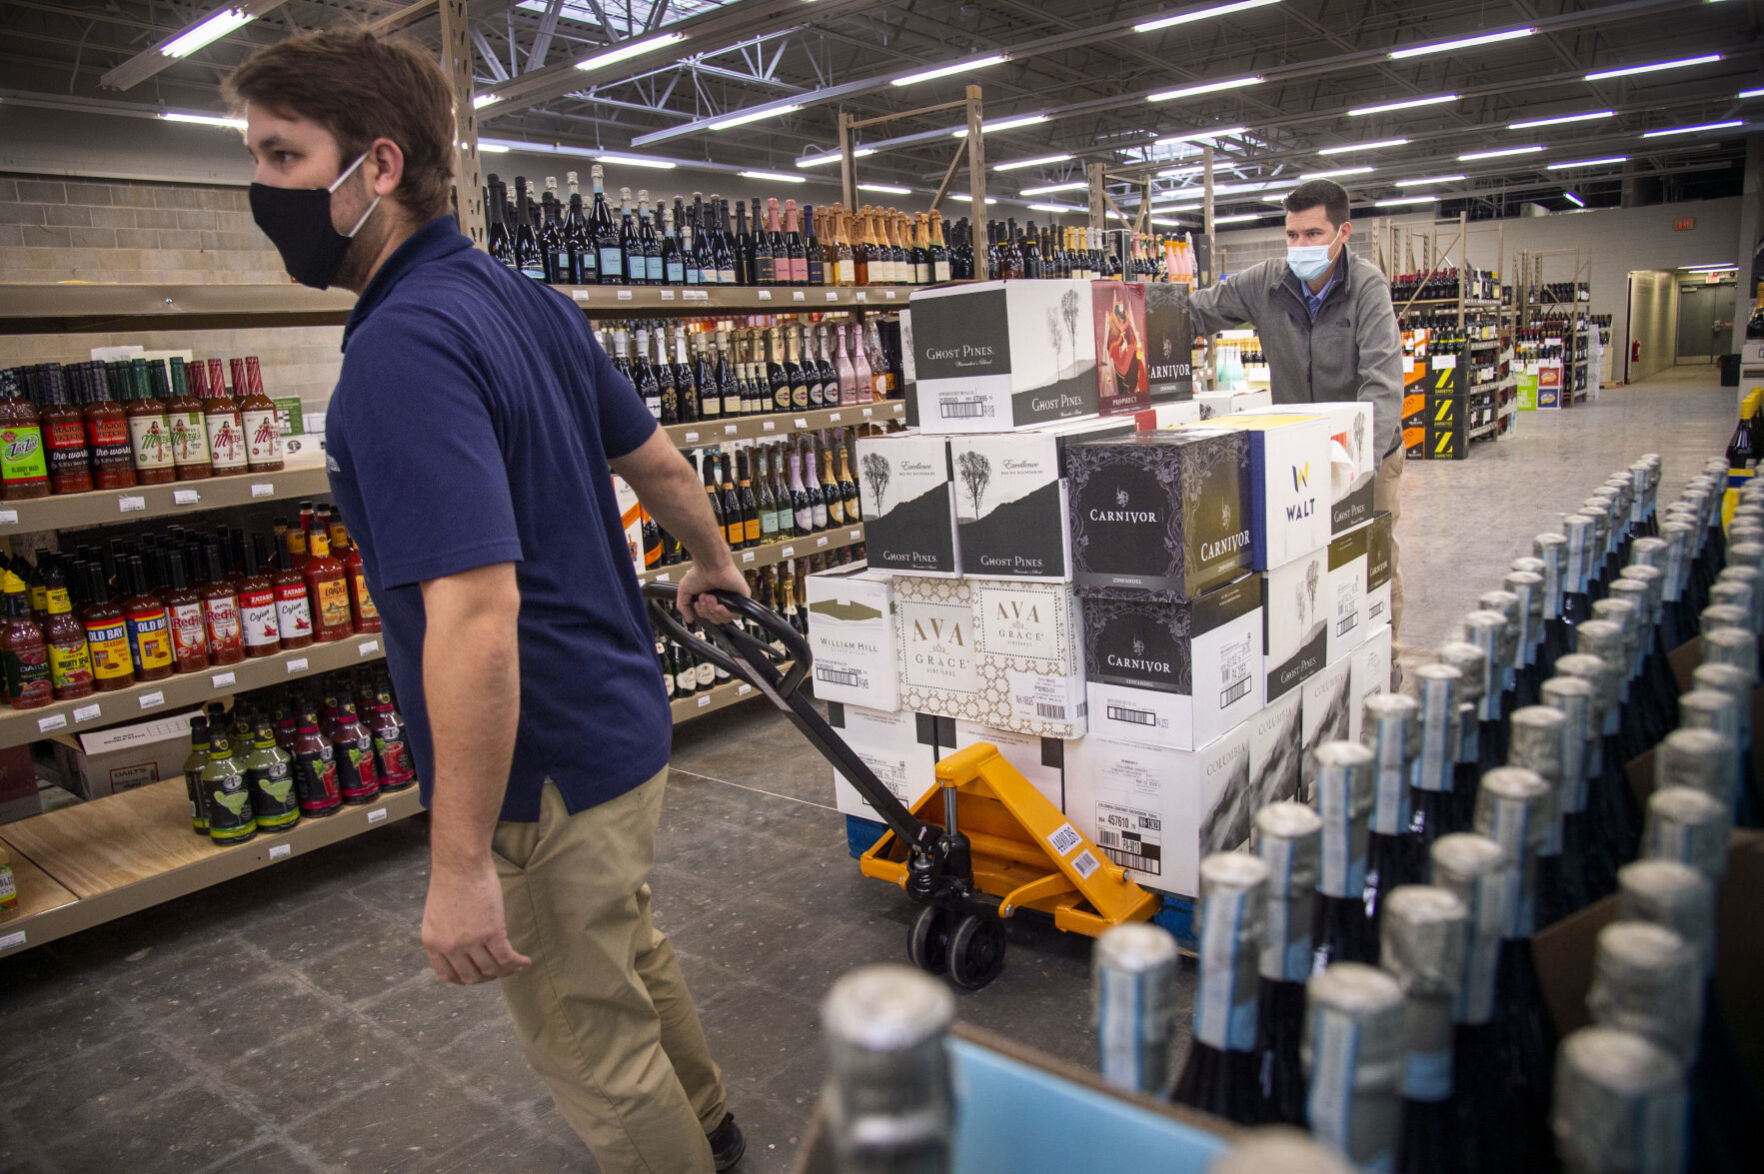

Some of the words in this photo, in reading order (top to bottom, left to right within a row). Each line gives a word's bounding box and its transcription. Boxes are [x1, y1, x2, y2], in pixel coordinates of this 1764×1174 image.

[926, 348, 959, 360] GHOST
[963, 344, 994, 358] PINES
[1148, 363, 1191, 379] ARNIVOR
[1031, 397, 1059, 412] GHOST
[1061, 393, 1083, 408] PINES
[1090, 509, 1157, 525] CARNIVOR
[1286, 498, 1315, 522] WALT
[1334, 510, 1350, 523] GHOST
[1201, 530, 1250, 562] CARNIVOR
[883, 551, 910, 562] GHOST
[912, 551, 937, 563] PINES
[980, 555, 1011, 567] GHOST
[1014, 556, 1043, 567] PINES
[249, 610, 270, 623] Cajun
[281, 603, 302, 615] Cajun
[997, 601, 1039, 623] AVA
[88, 629, 105, 641] OLD
[107, 627, 123, 638] BAY
[138, 621, 156, 632] OLD
[913, 618, 964, 646] AVA
[999, 630, 1041, 641] GRACE
[820, 637, 855, 649] WILLIAM
[858, 642, 878, 652] HILL
[915, 654, 967, 669] GRACE
[1107, 654, 1172, 673] CARNIVOR
[1281, 668, 1299, 684] GHOST
[1107, 814, 1129, 828] 457610
